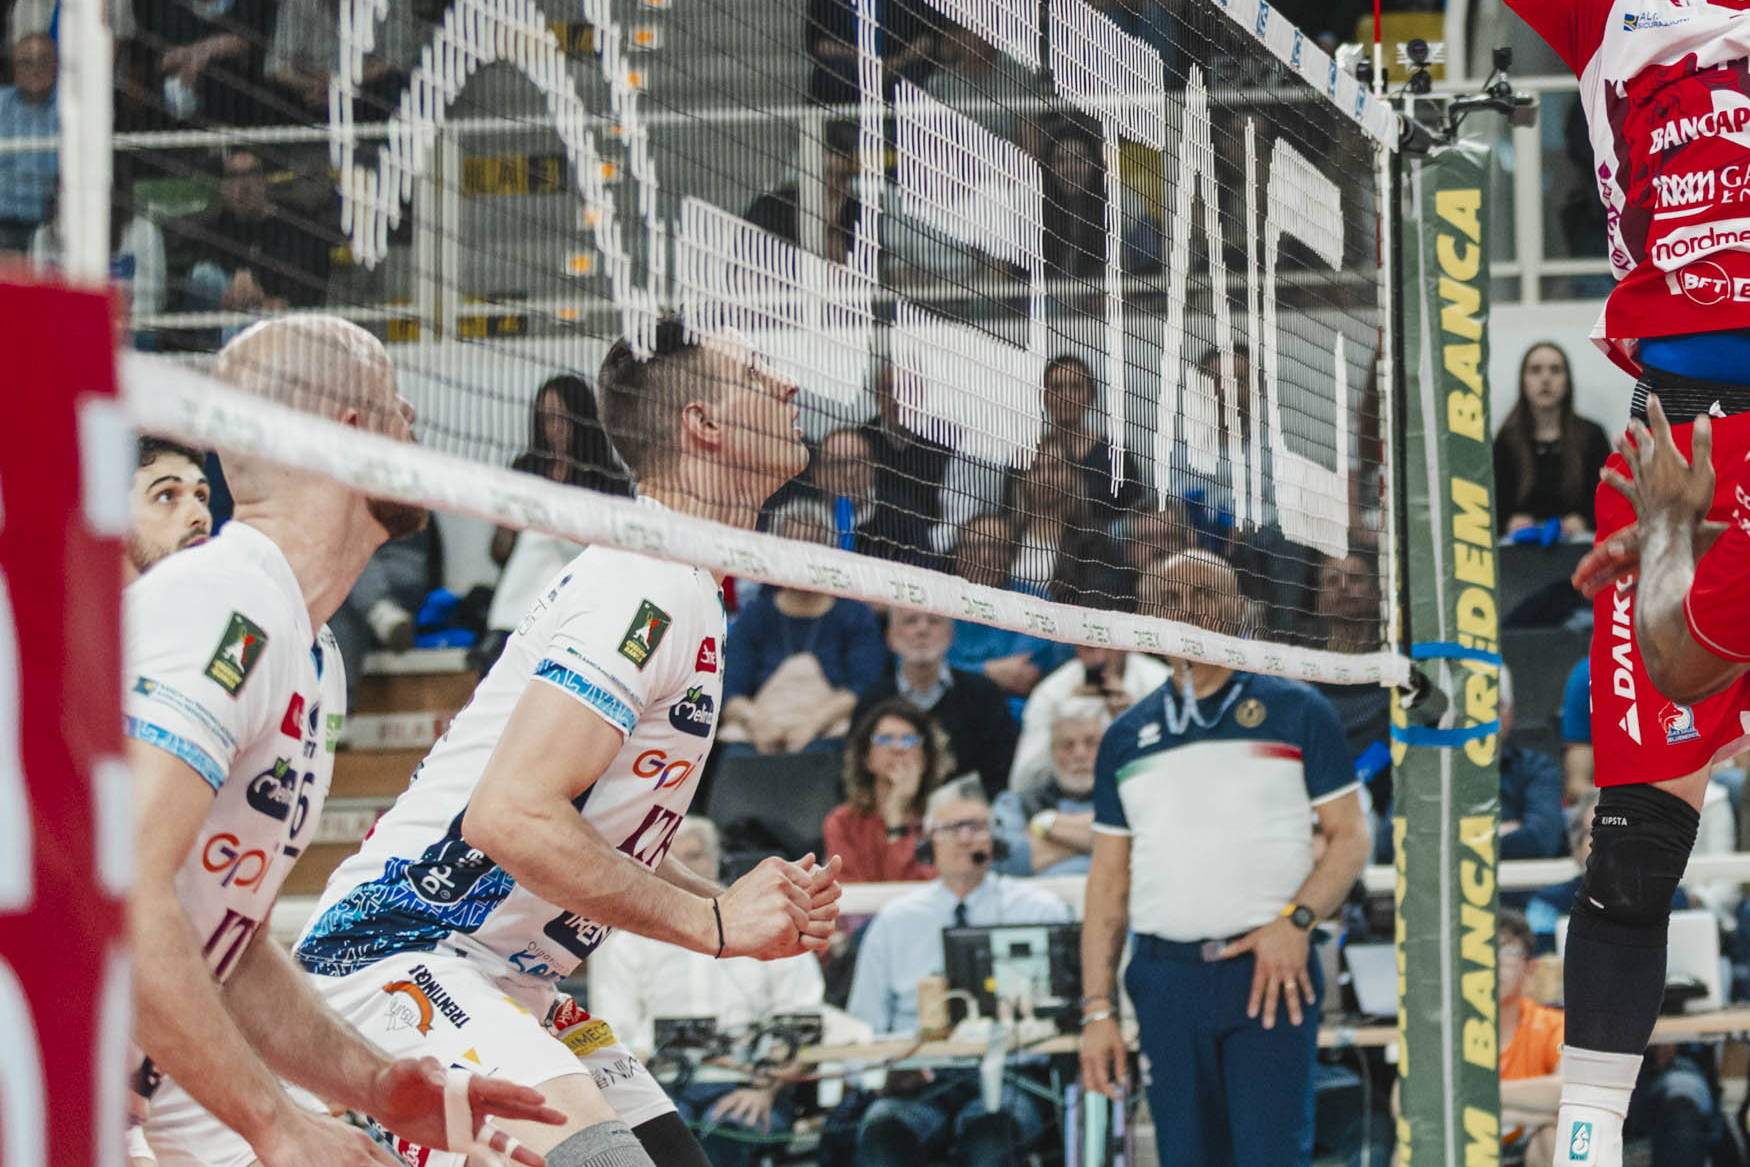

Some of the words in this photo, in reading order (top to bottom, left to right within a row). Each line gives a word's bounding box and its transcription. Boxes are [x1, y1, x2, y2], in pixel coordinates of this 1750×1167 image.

[1435, 188, 1485, 442] BANCA
[1683, 273, 1727, 294] BFT
[1459, 814, 1497, 1070] BANCA
